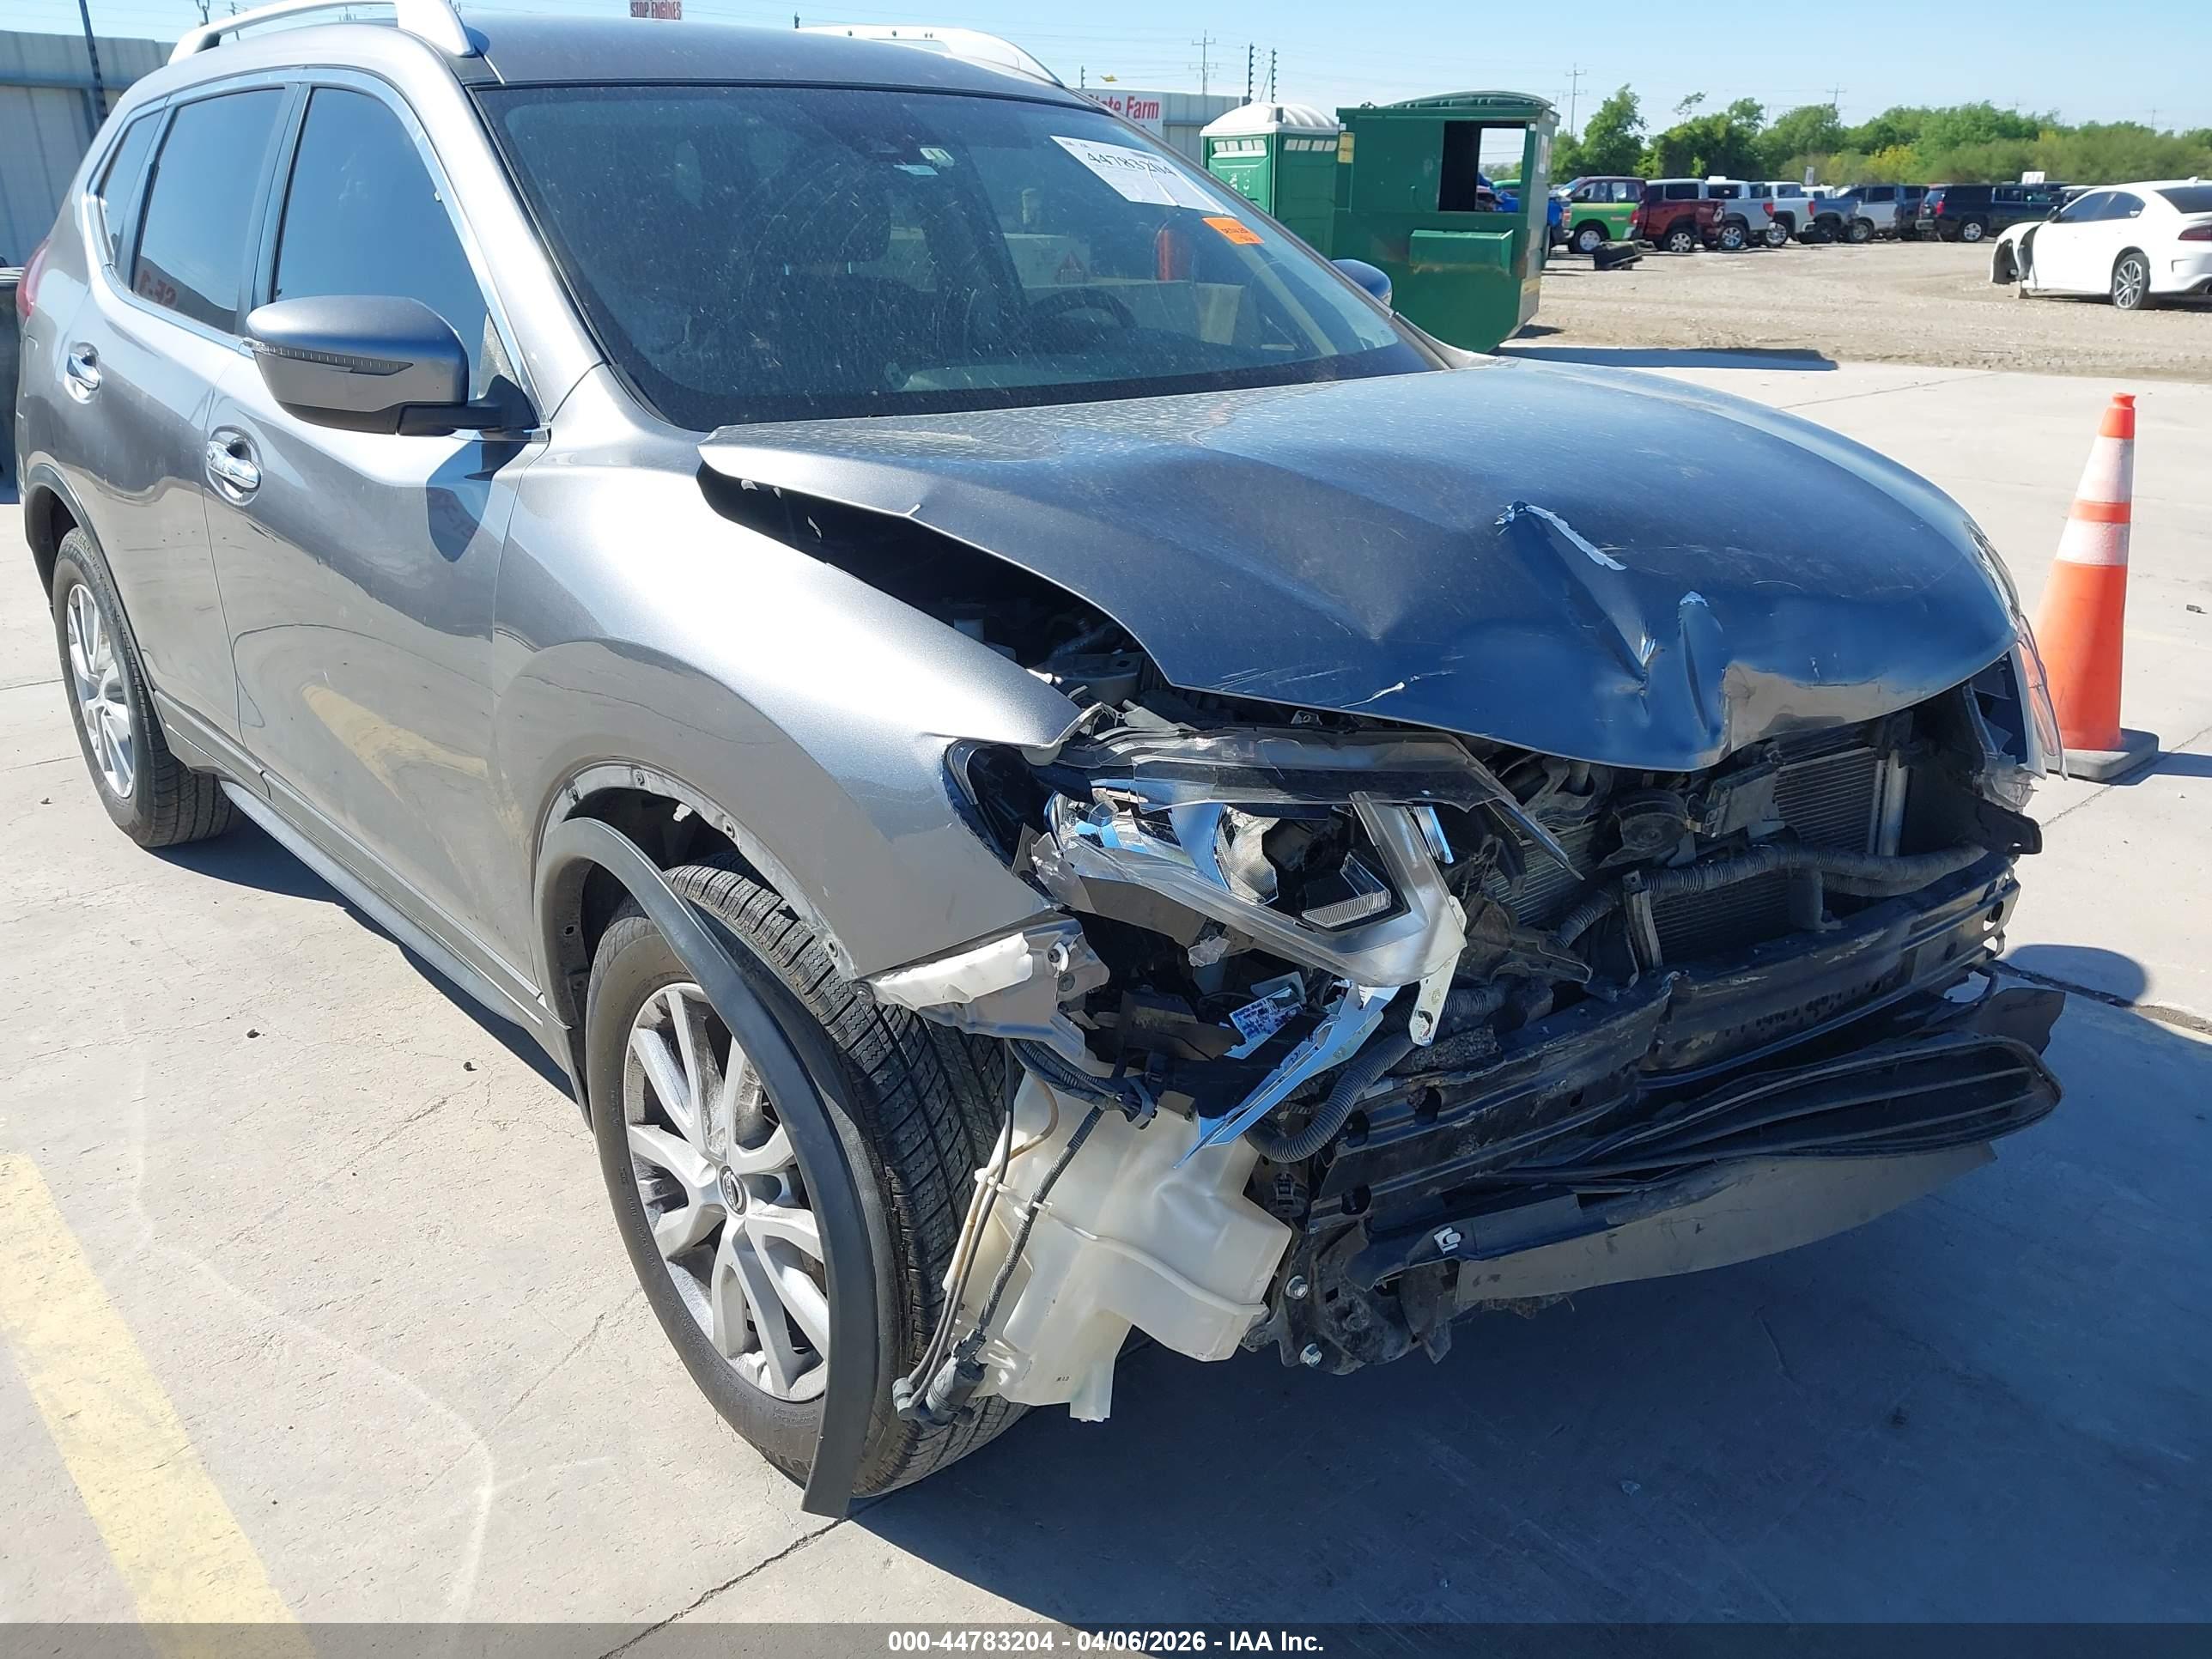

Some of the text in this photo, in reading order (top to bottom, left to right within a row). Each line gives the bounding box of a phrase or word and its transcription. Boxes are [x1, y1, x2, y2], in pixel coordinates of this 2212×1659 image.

[630, 2, 682, 20] STOP ENGINES
[1126, 95, 1160, 119] Farm
